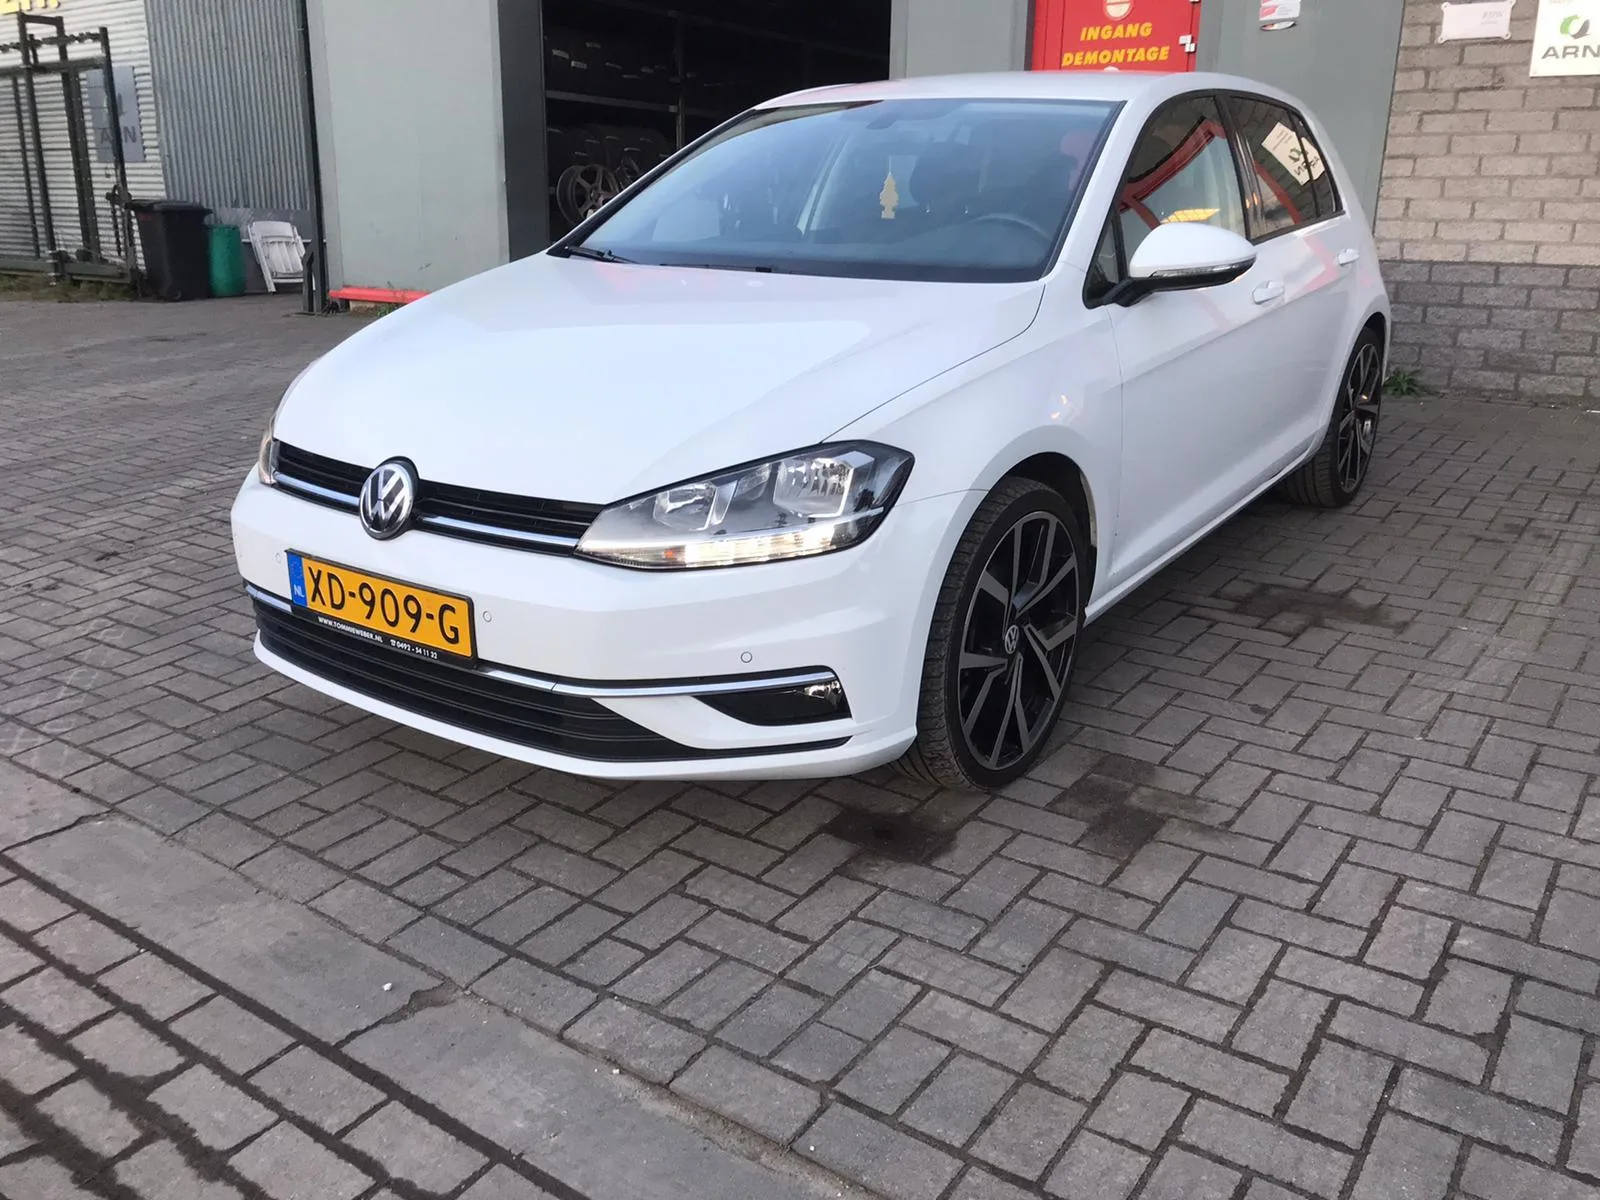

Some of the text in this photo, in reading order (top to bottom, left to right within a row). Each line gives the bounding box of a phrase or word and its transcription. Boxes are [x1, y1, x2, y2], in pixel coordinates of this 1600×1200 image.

[1080, 22, 1152, 41] INGANG
[1061, 46, 1170, 67] DEMONTAGE
[1541, 45, 1600, 60] ARN
[100, 126, 137, 144] AN
[293, 584, 305, 598] NL
[308, 566, 460, 645] XD-909-G
